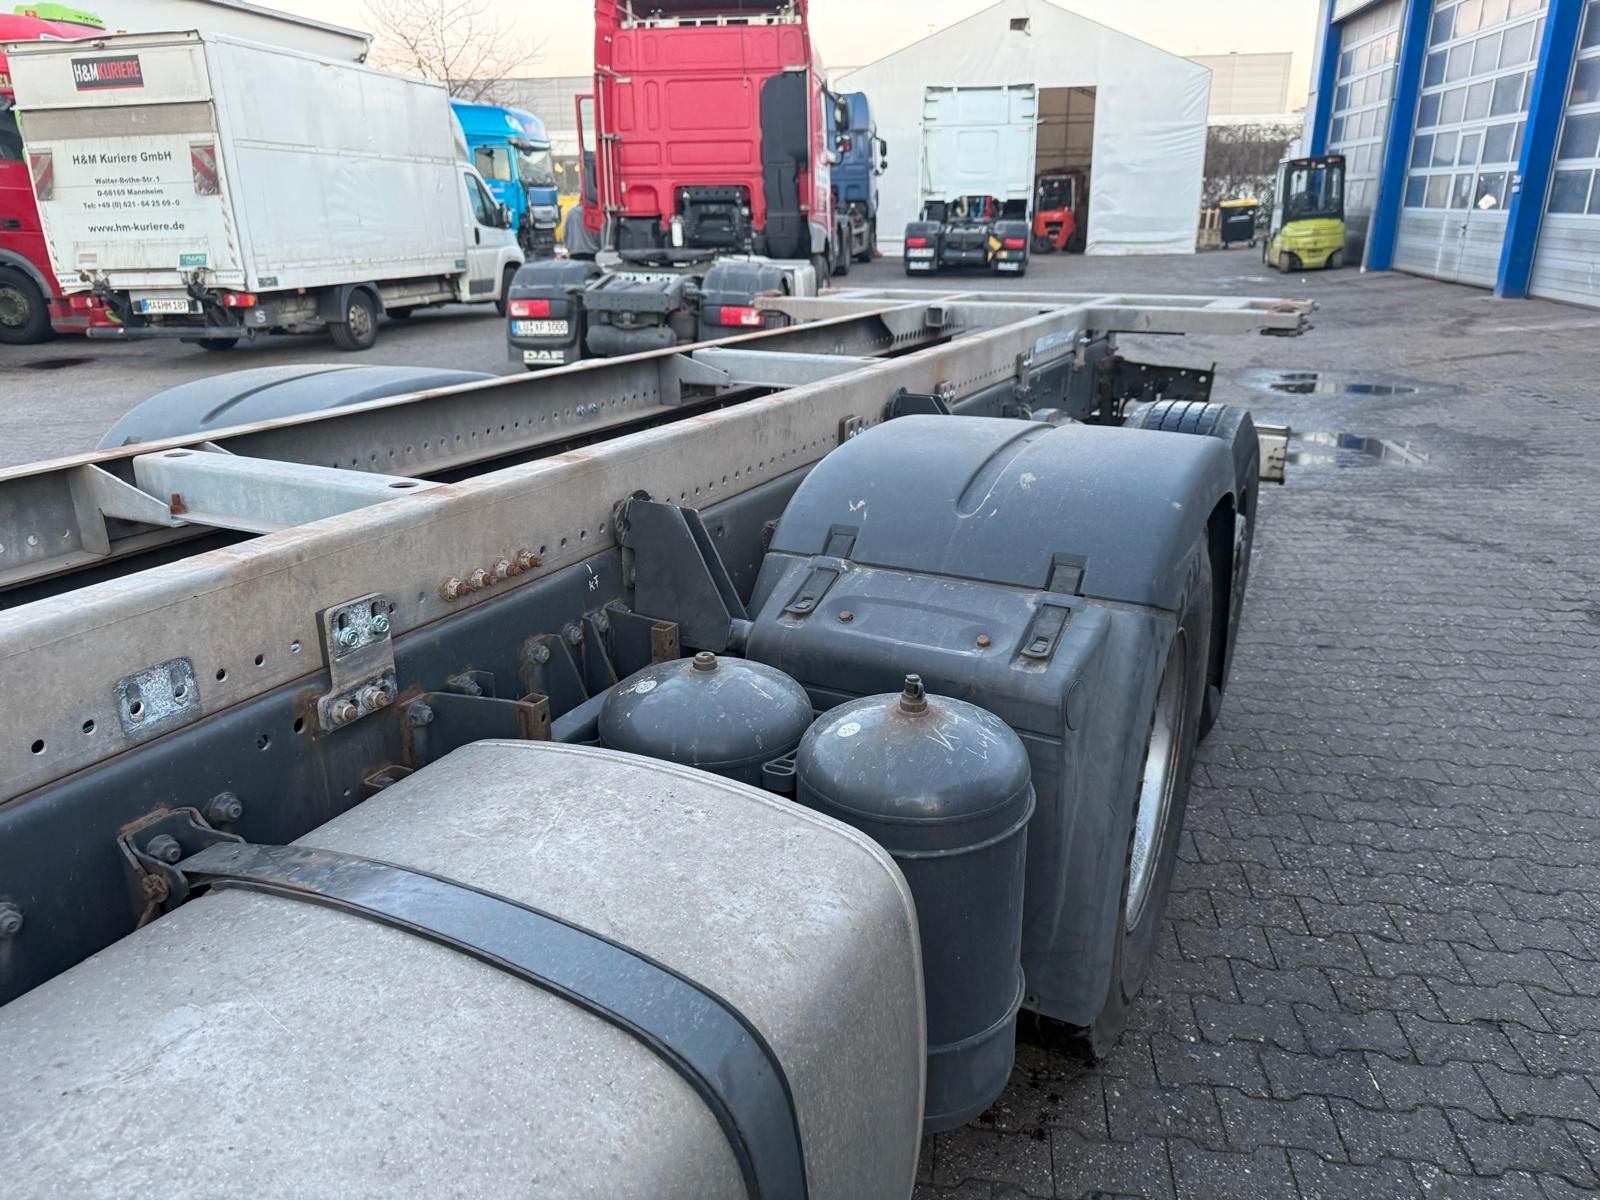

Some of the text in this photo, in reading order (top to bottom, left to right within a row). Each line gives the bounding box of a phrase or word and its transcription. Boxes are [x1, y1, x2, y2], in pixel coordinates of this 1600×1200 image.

[72, 151, 172, 165] H&M Kuriere GmbH
[87, 221, 186, 233] www.hm-kuriere.de
[255, 310, 266, 323] S
[523, 350, 564, 360] DAF
